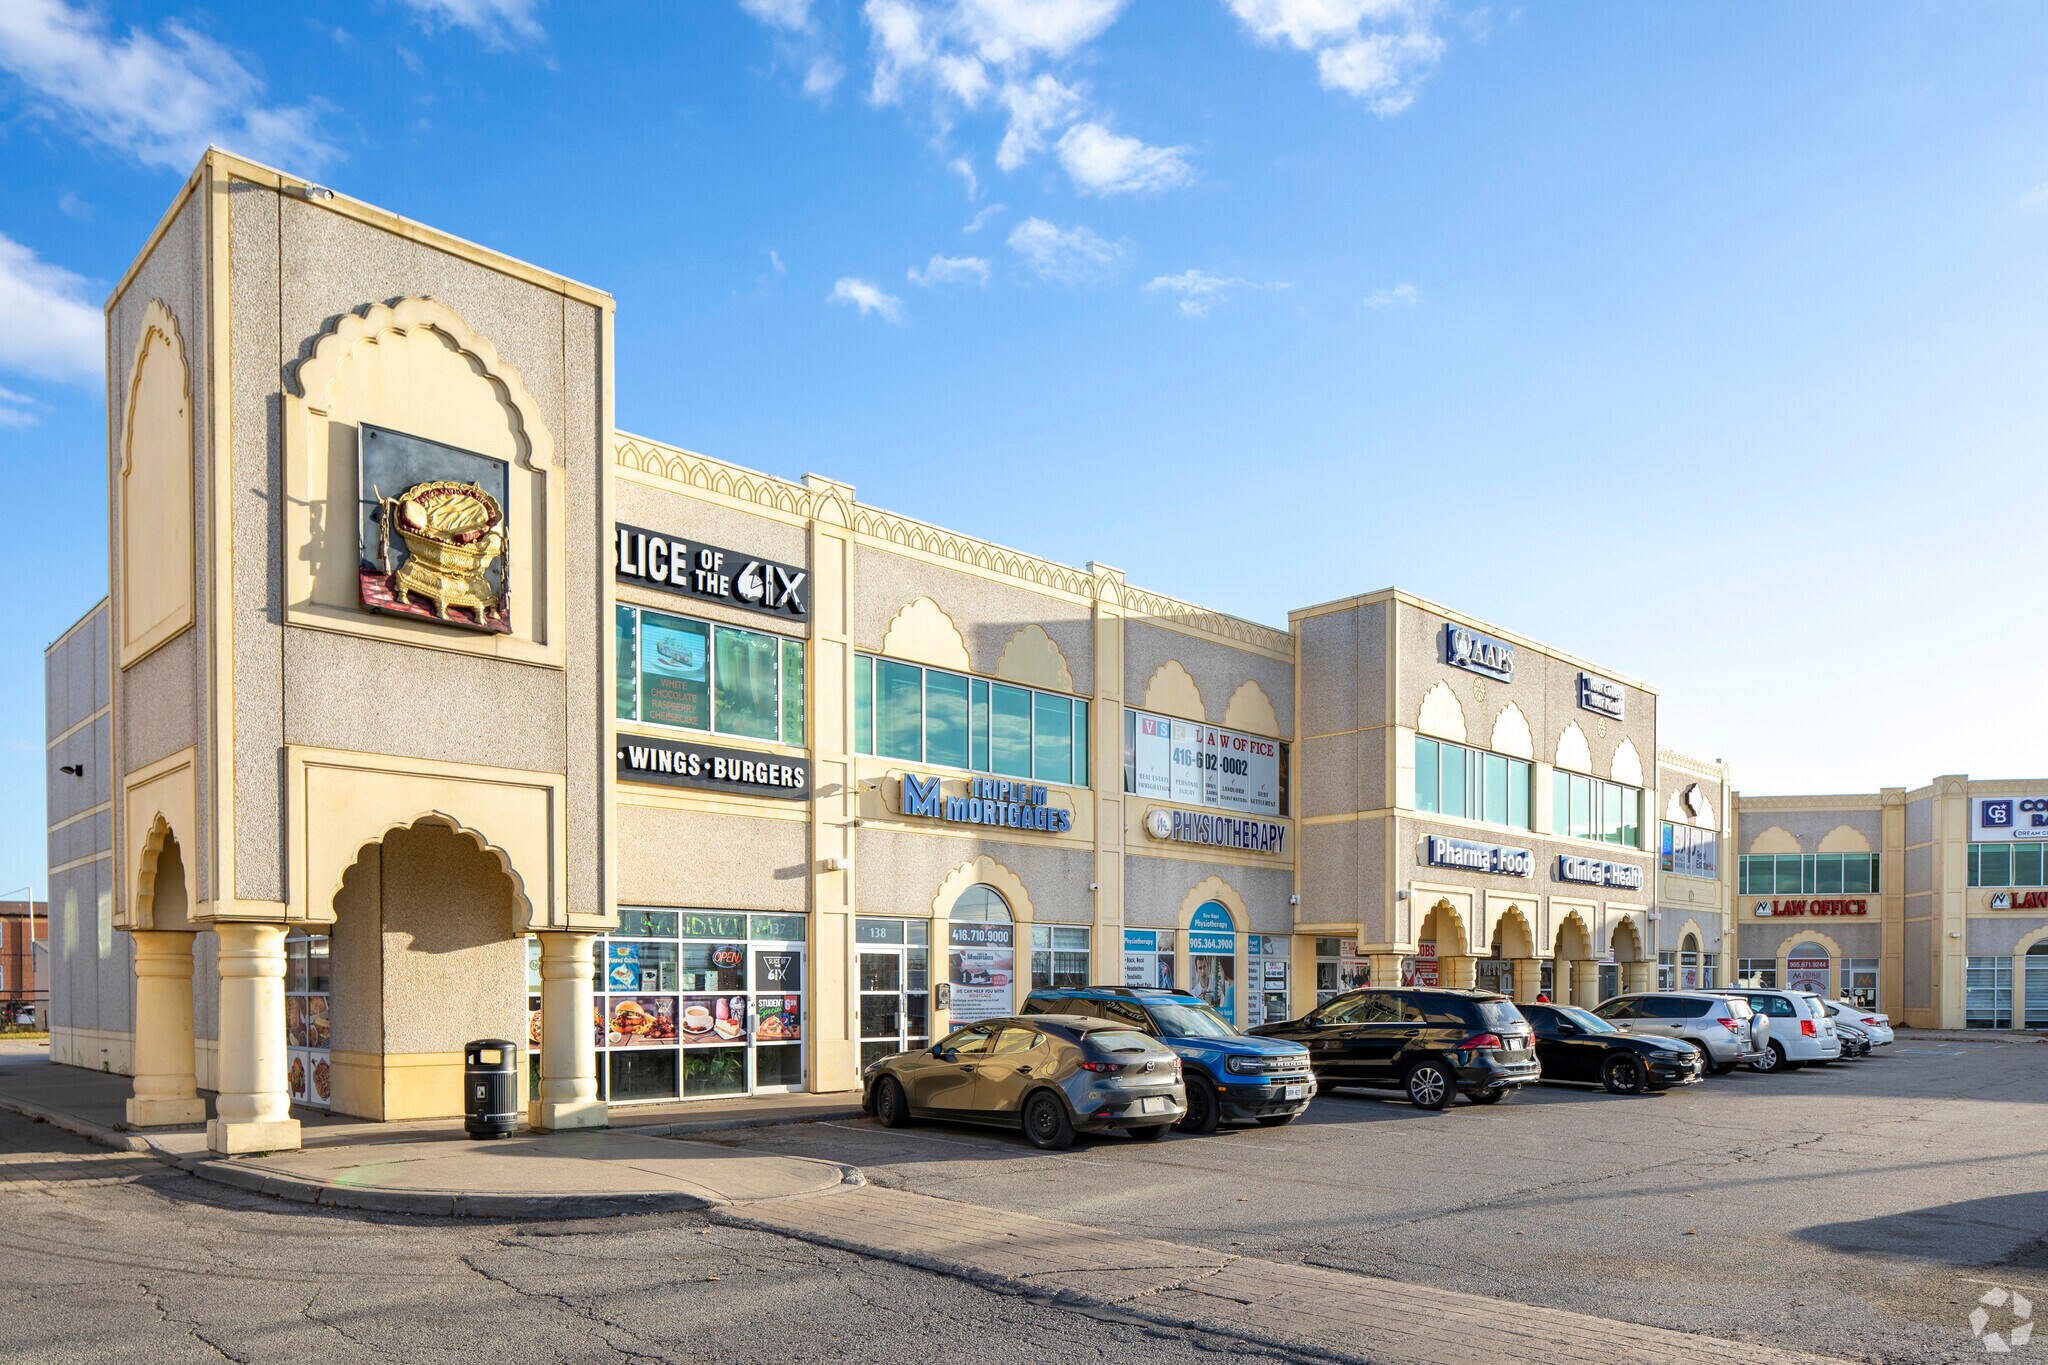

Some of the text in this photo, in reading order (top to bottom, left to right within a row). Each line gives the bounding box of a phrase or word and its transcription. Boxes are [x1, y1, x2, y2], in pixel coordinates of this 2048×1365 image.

[700, 549, 724, 571] OF
[695, 569, 729, 597] THE
[1472, 639, 1514, 673] AAPS
[660, 678, 687, 690] WHITE
[651, 688, 697, 703] CHOCOLATE
[652, 700, 697, 713] RASPBERRY
[649, 711, 698, 725] CHEESECAKE
[627, 745, 805, 788] WINGS BURGERS
[1173, 747, 1248, 776] 416-602-0002
[971, 776, 1048, 806] TRIPLE M
[1257, 790, 1269, 798] DEBT
[2019, 799, 2048, 812] CO
[946, 795, 1071, 833] MORTGAGES
[1172, 810, 1285, 853] PHYSIOTHERAPY
[1436, 839, 1490, 867] Pharma
[1565, 857, 1644, 887] Clinical Health
[1773, 899, 1867, 916] LAW OFFICE
[1194, 919, 1228, 929] Physiotherapy
[870, 927, 887, 939] 138
[952, 929, 1009, 943] 416.710.9000
[1189, 938, 1233, 949] 905.364.3900
[1417, 944, 1436, 957] OBS
[714, 951, 739, 963] OPEN
[758, 999, 784, 1008] STUDENT
